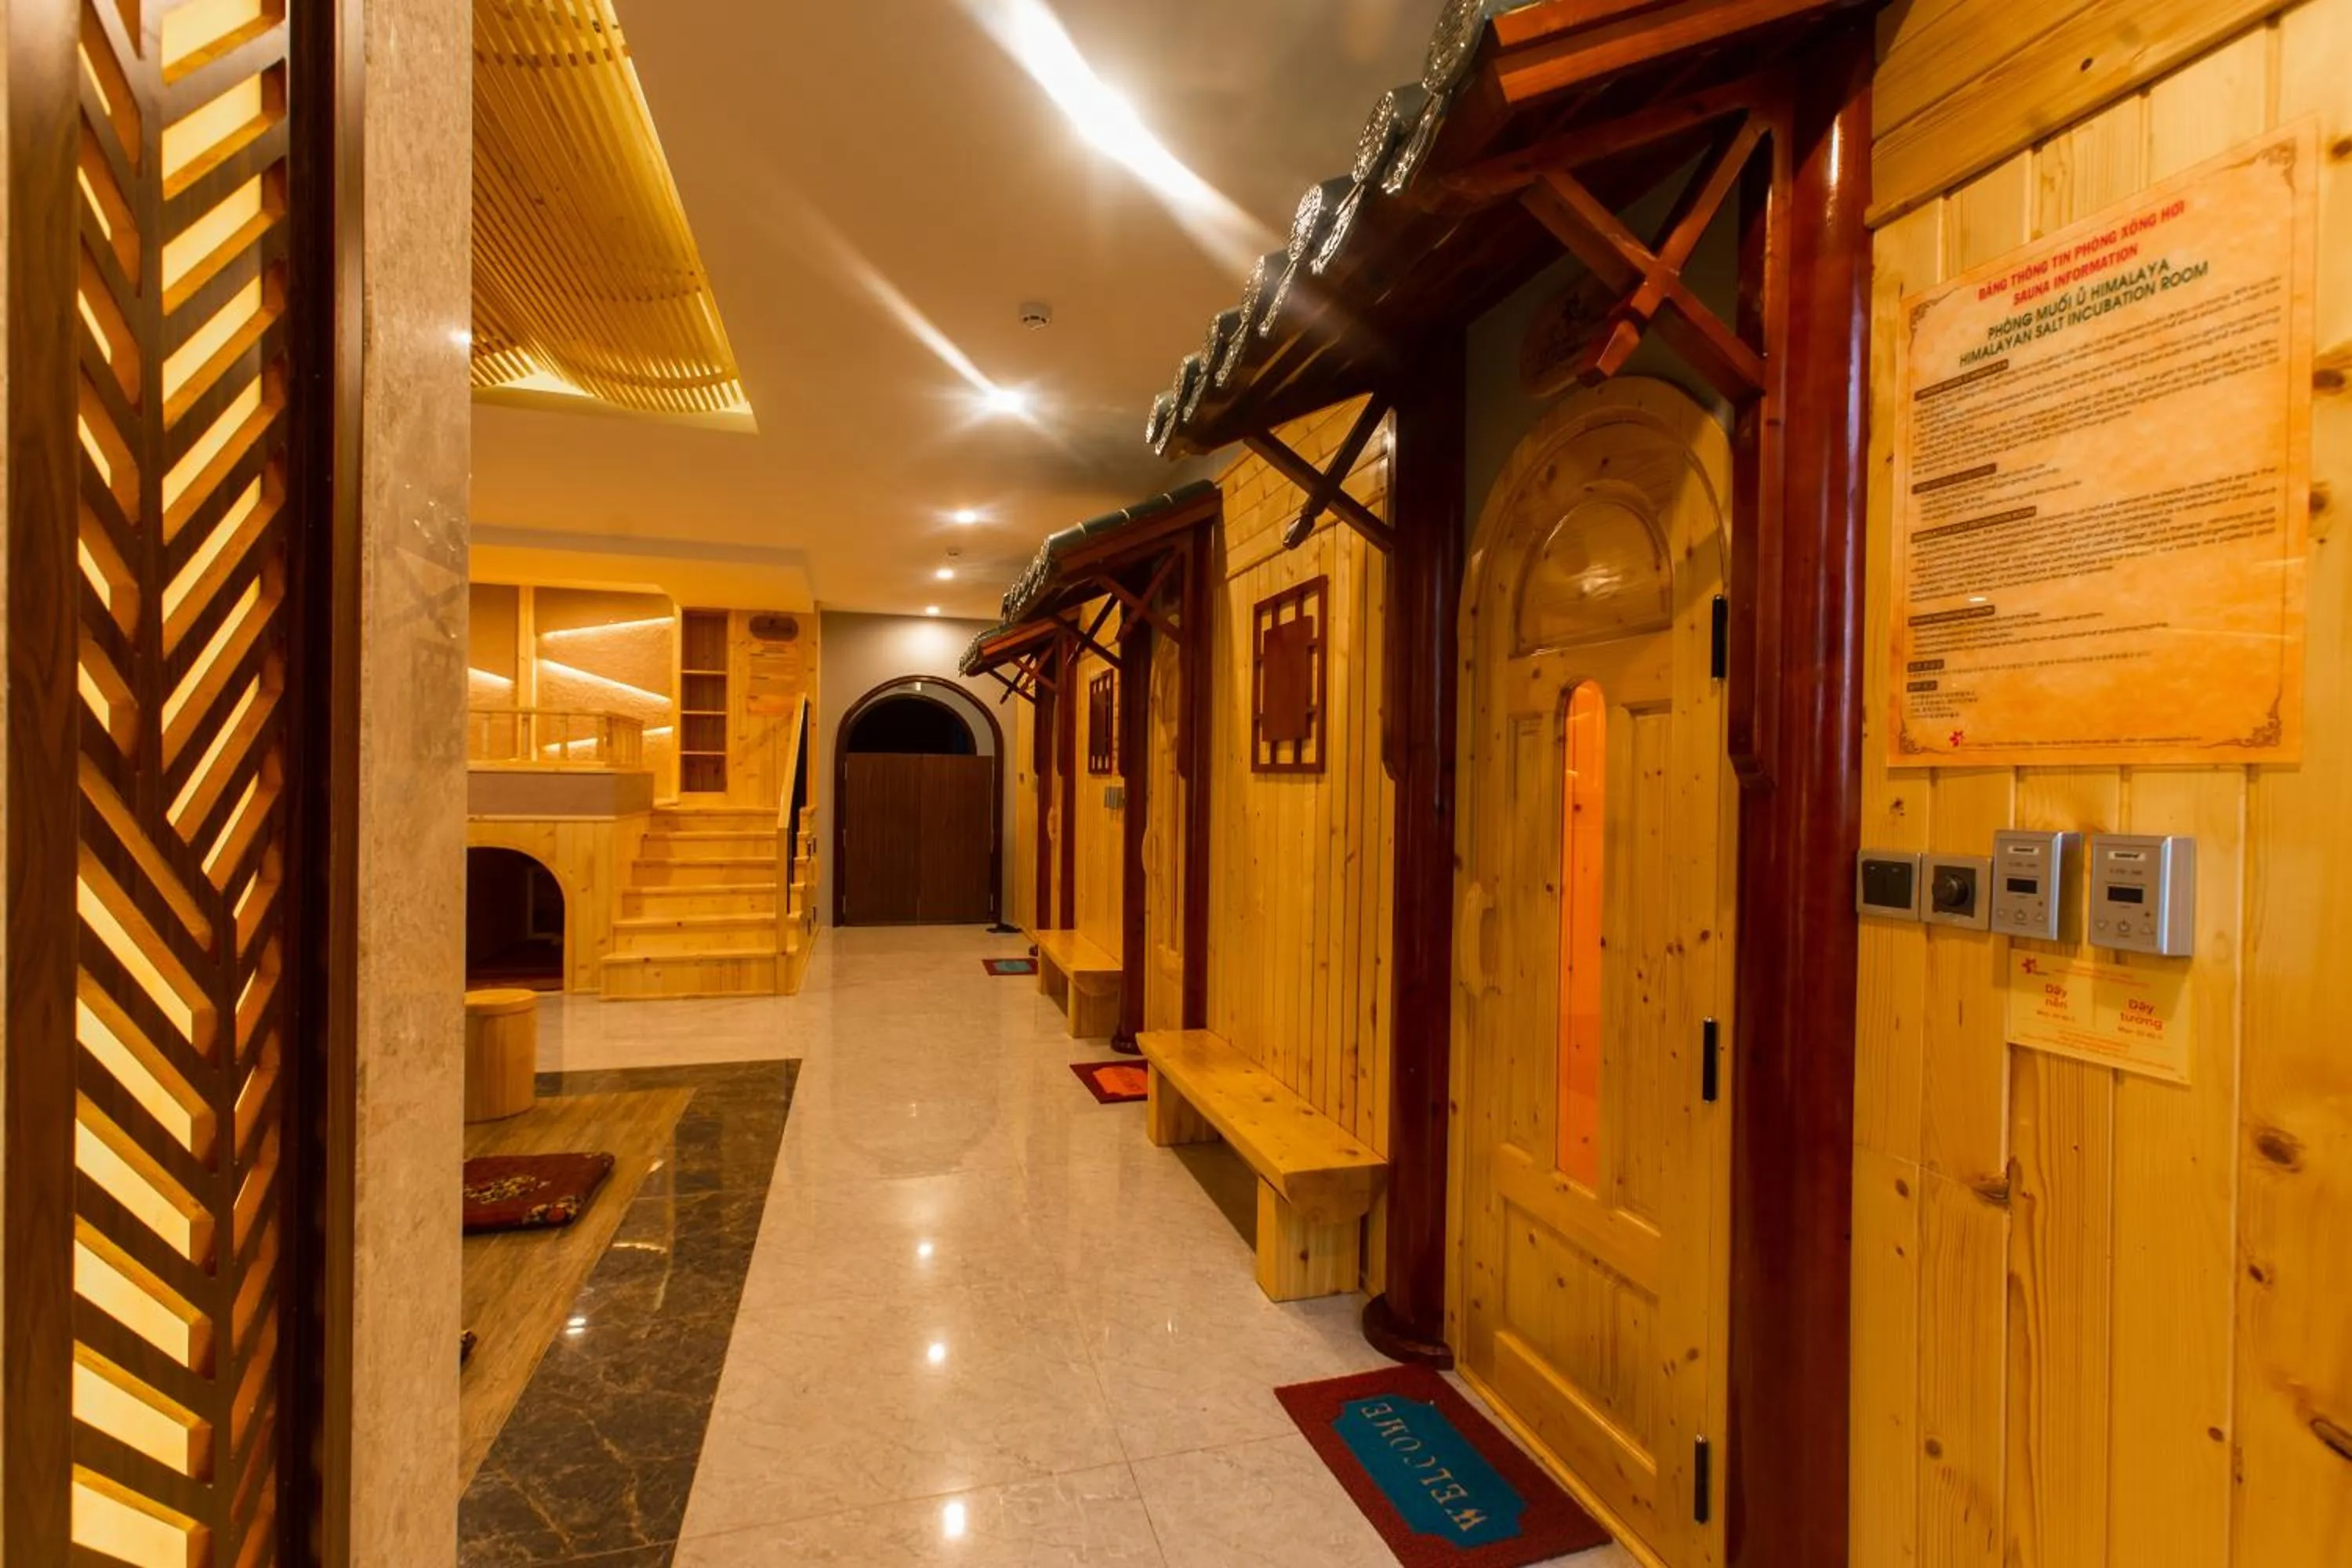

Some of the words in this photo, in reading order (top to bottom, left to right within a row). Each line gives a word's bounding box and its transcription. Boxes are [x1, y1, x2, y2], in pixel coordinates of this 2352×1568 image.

[2011, 260, 2048, 286] THÔNG
[2052, 250, 2071, 272] TIN
[2074, 230, 2117, 260] PHÒNG
[2120, 212, 2157, 240] XÔNG
[2013, 280, 2050, 306] SAUNA
[2054, 242, 2138, 289] INFORMATION
[1958, 328, 2032, 367] HIMALAYAN
[2035, 316, 2063, 337] SALT
[2067, 282, 2156, 325] INCUBATION
[2161, 261, 2209, 290] ROOM
[1987, 312, 2033, 339] PHÒNG
[2036, 291, 2071, 320] MUỐI
[2090, 258, 2169, 301] HIMALAYA
[1360, 1402, 1489, 1532] WELCOME
